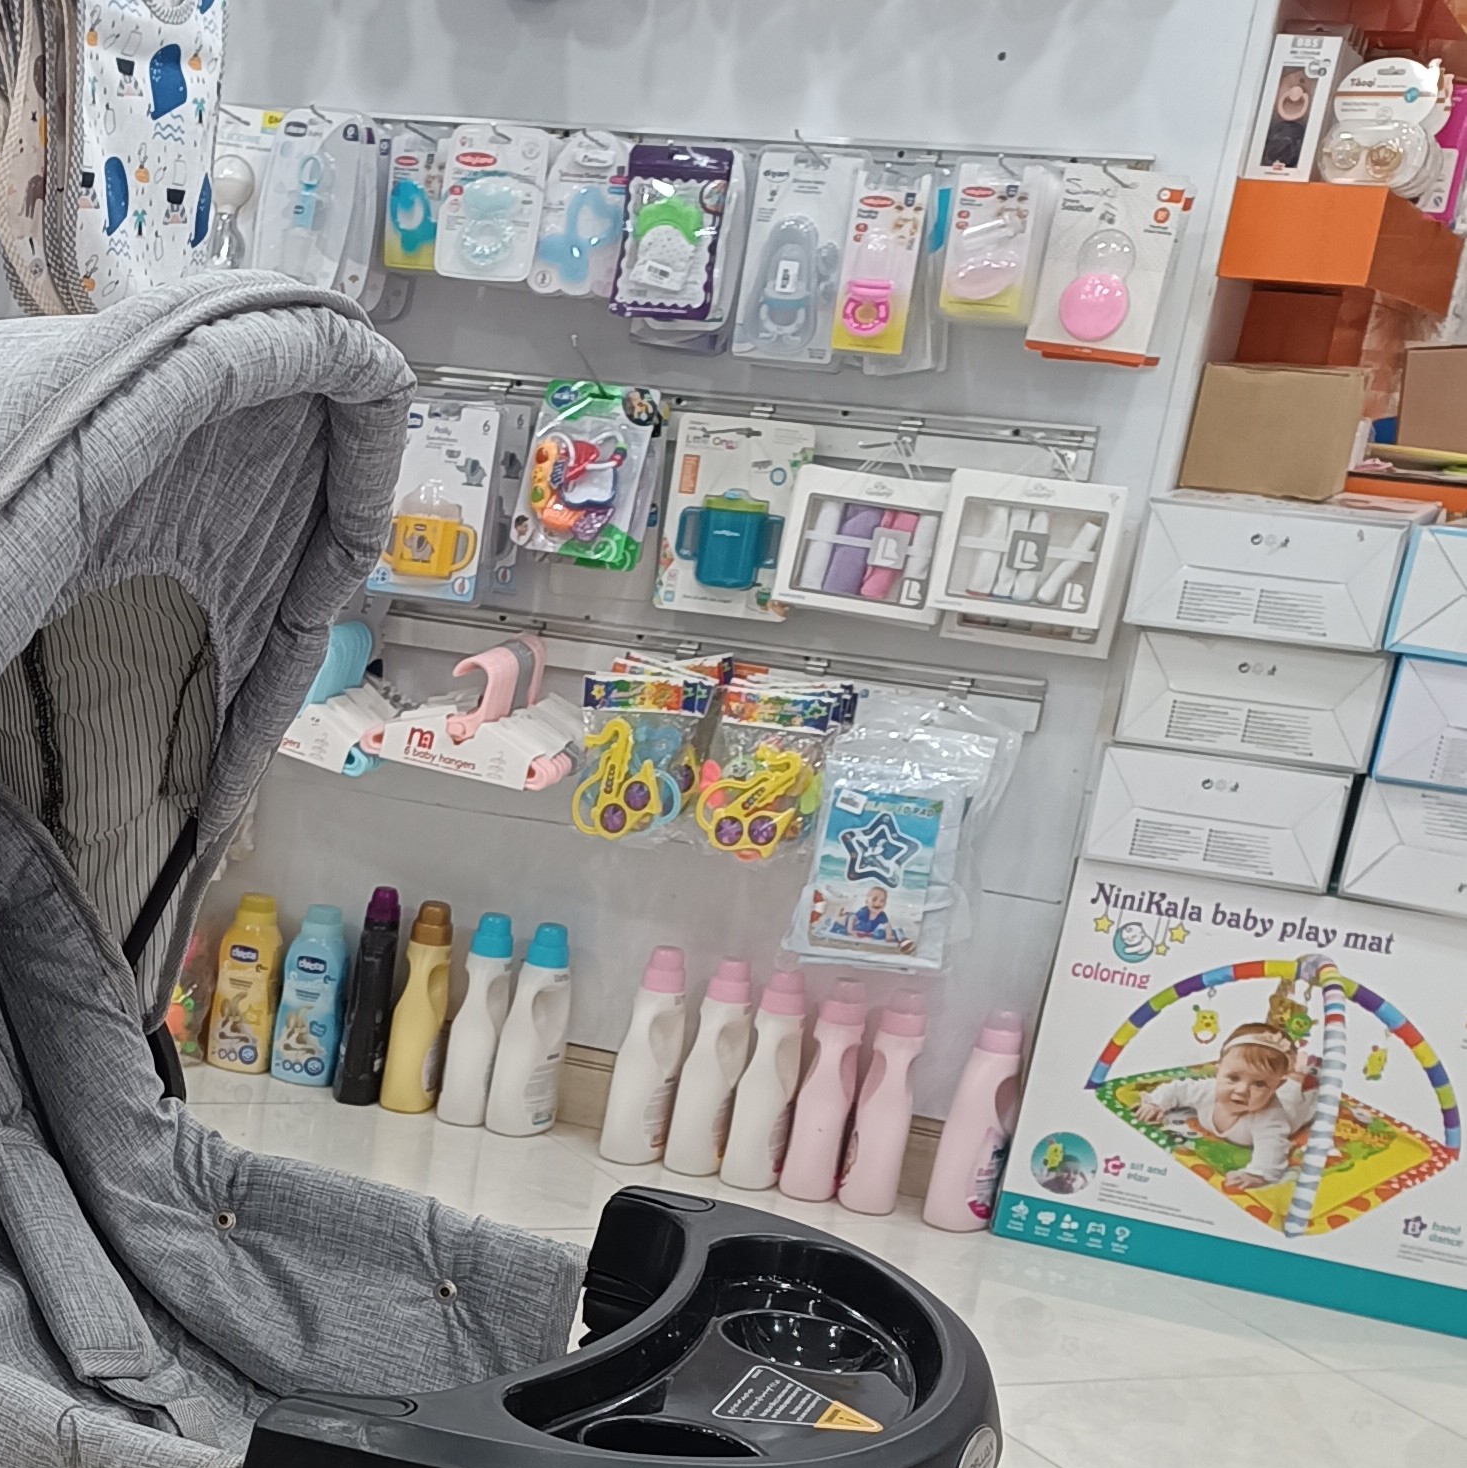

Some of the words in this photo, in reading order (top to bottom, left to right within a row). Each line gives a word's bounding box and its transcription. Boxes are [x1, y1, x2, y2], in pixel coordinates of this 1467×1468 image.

[482, 419, 491, 433] 6
[282, 737, 301, 749] gers
[403, 746, 411, 757] 6
[412, 749, 437, 762] baby
[439, 753, 476, 771] hangers
[1091, 882, 1203, 923] NiniKala
[1211, 902, 1274, 938] baby
[1280, 915, 1338, 948] play
[1343, 927, 1396, 956] mat
[1071, 961, 1151, 990] coloring
